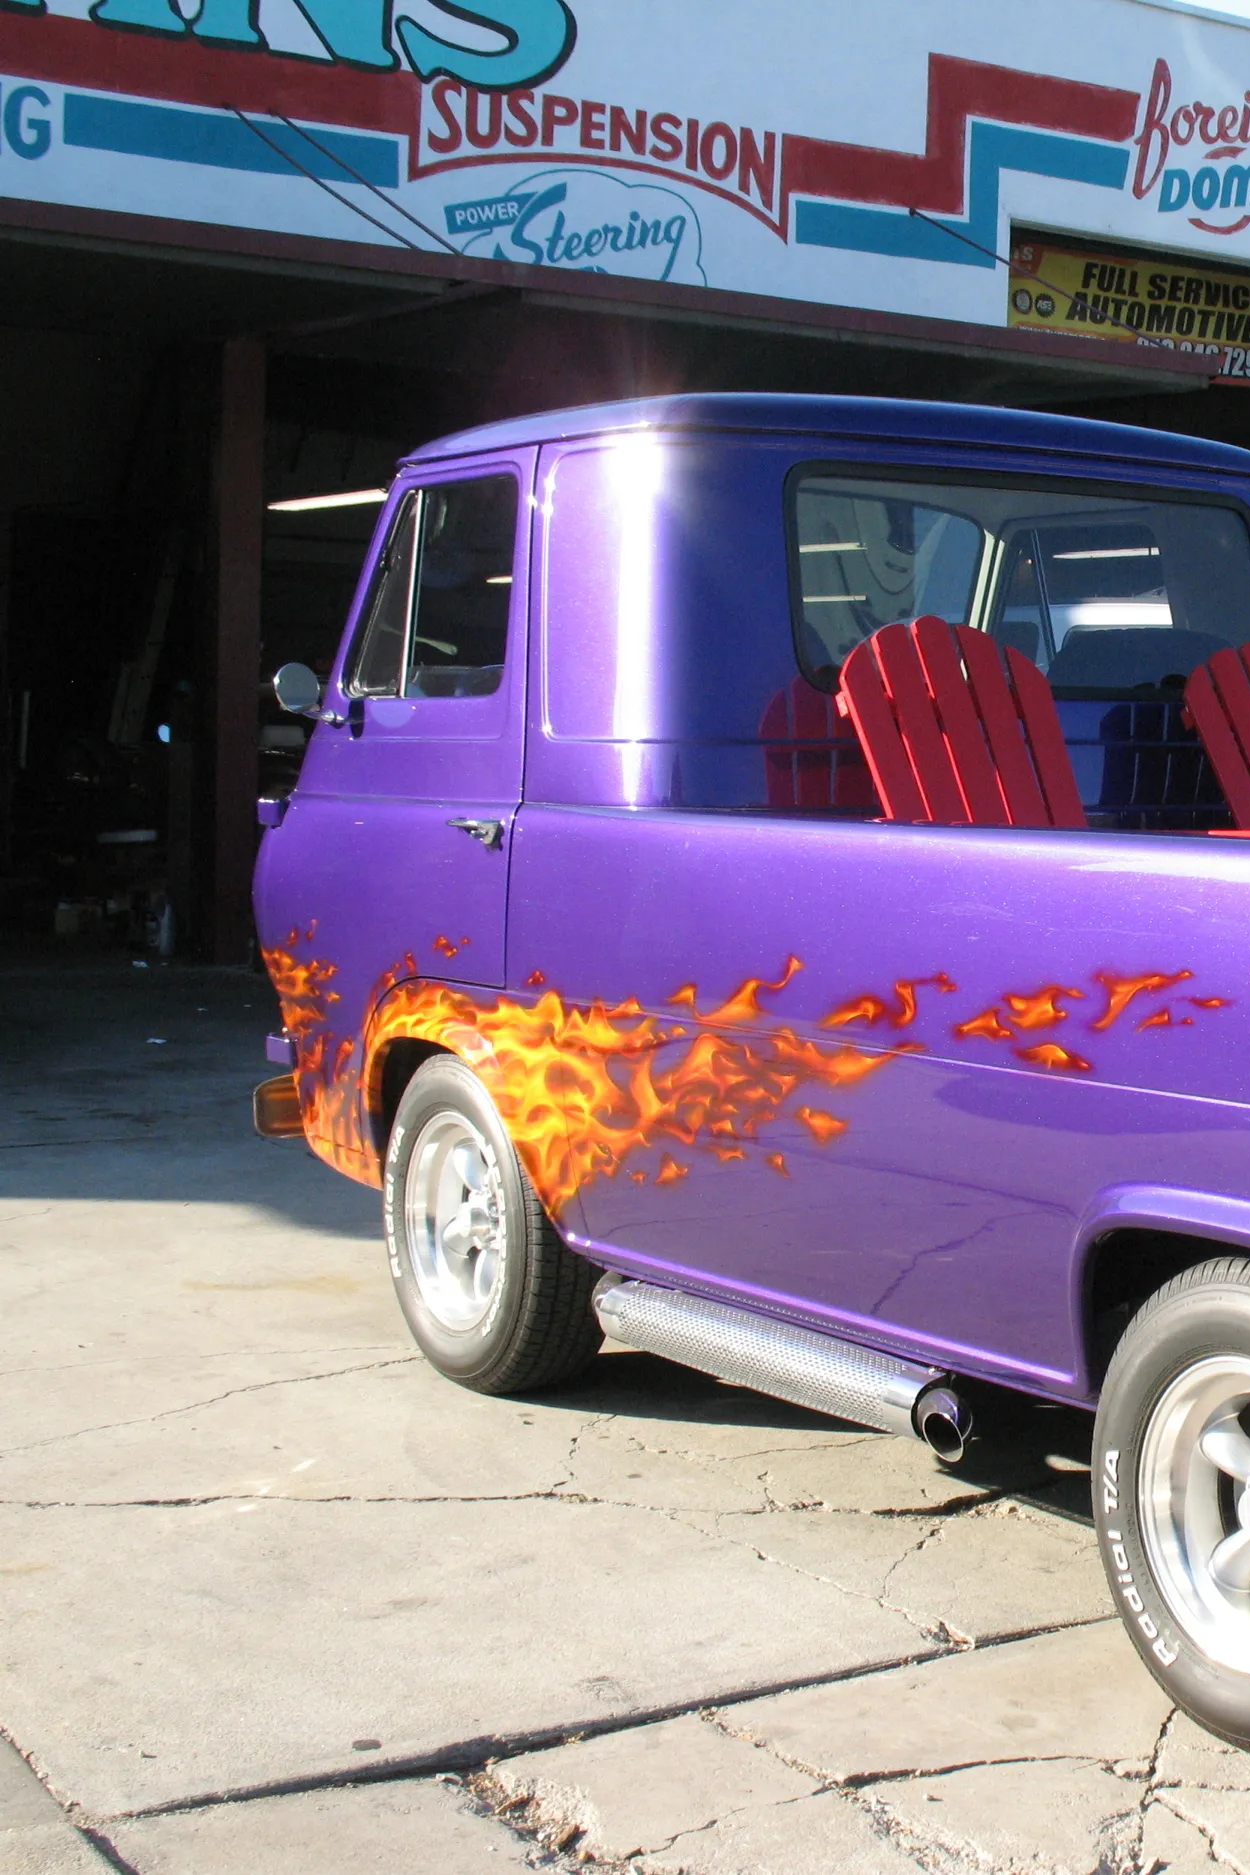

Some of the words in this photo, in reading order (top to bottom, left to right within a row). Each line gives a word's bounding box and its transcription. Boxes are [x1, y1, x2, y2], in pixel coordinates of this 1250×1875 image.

[0, 82, 51, 161] G
[428, 78, 776, 213] SUSPENSION
[455, 202, 520, 225] POWER
[493, 182, 688, 281] Steering
[1082, 261, 1140, 298] FULL
[1103, 1450, 1120, 1514] T/A
[1108, 1529, 1177, 1668] Radial
